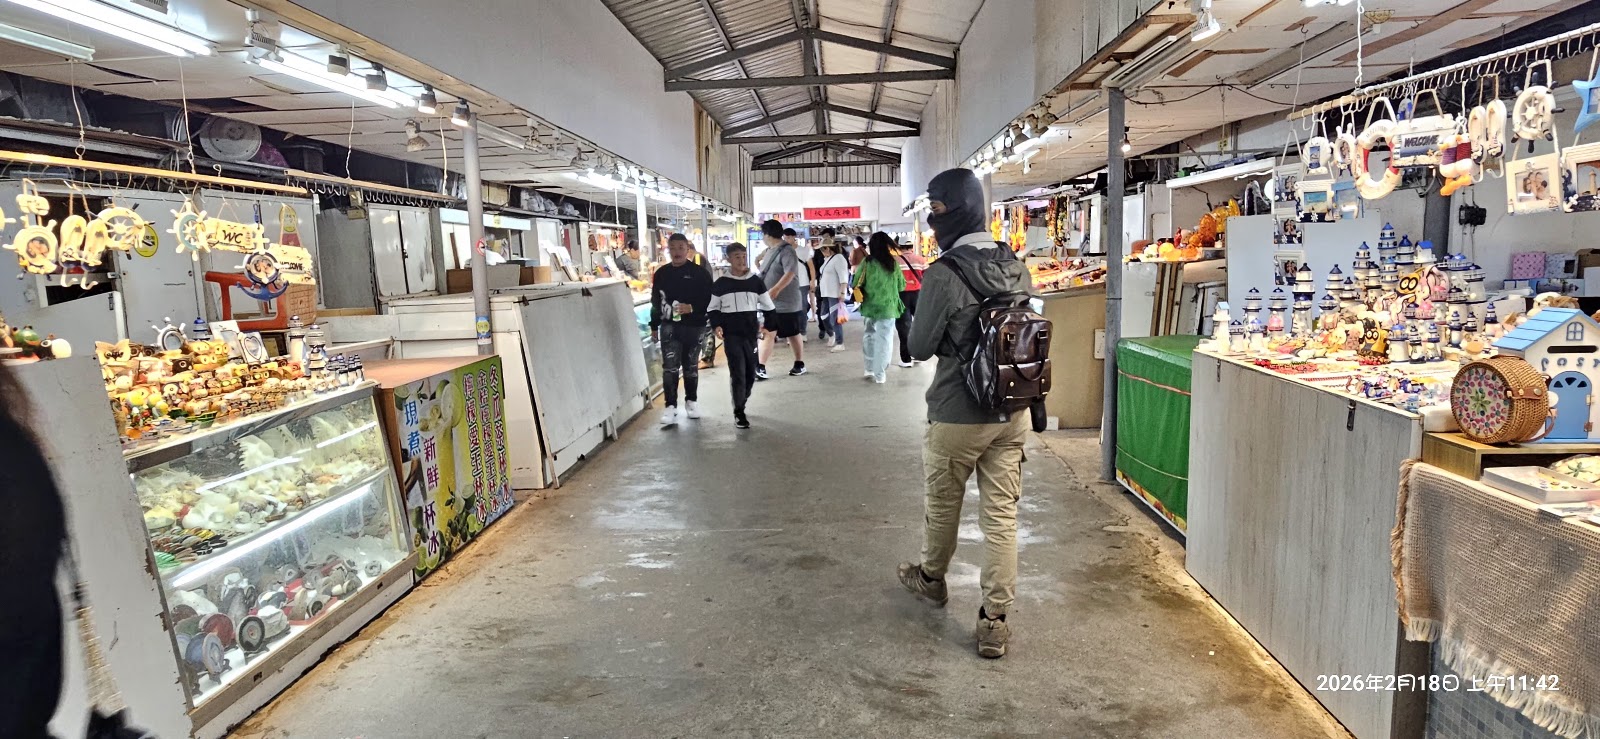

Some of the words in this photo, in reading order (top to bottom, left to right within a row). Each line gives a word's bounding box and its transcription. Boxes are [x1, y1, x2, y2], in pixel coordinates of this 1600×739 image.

[1404, 134, 1440, 147] WELCOME
[222, 230, 243, 244] WC
[280, 261, 303, 271] COME
[404, 400, 421, 459] 現煮
[463, 373, 488, 523] 檸檬愛玉杯冰
[489, 364, 510, 504] 冬瓜茶杯冰
[423, 436, 439, 491] 新鮮
[423, 500, 440, 556] 杯冰
